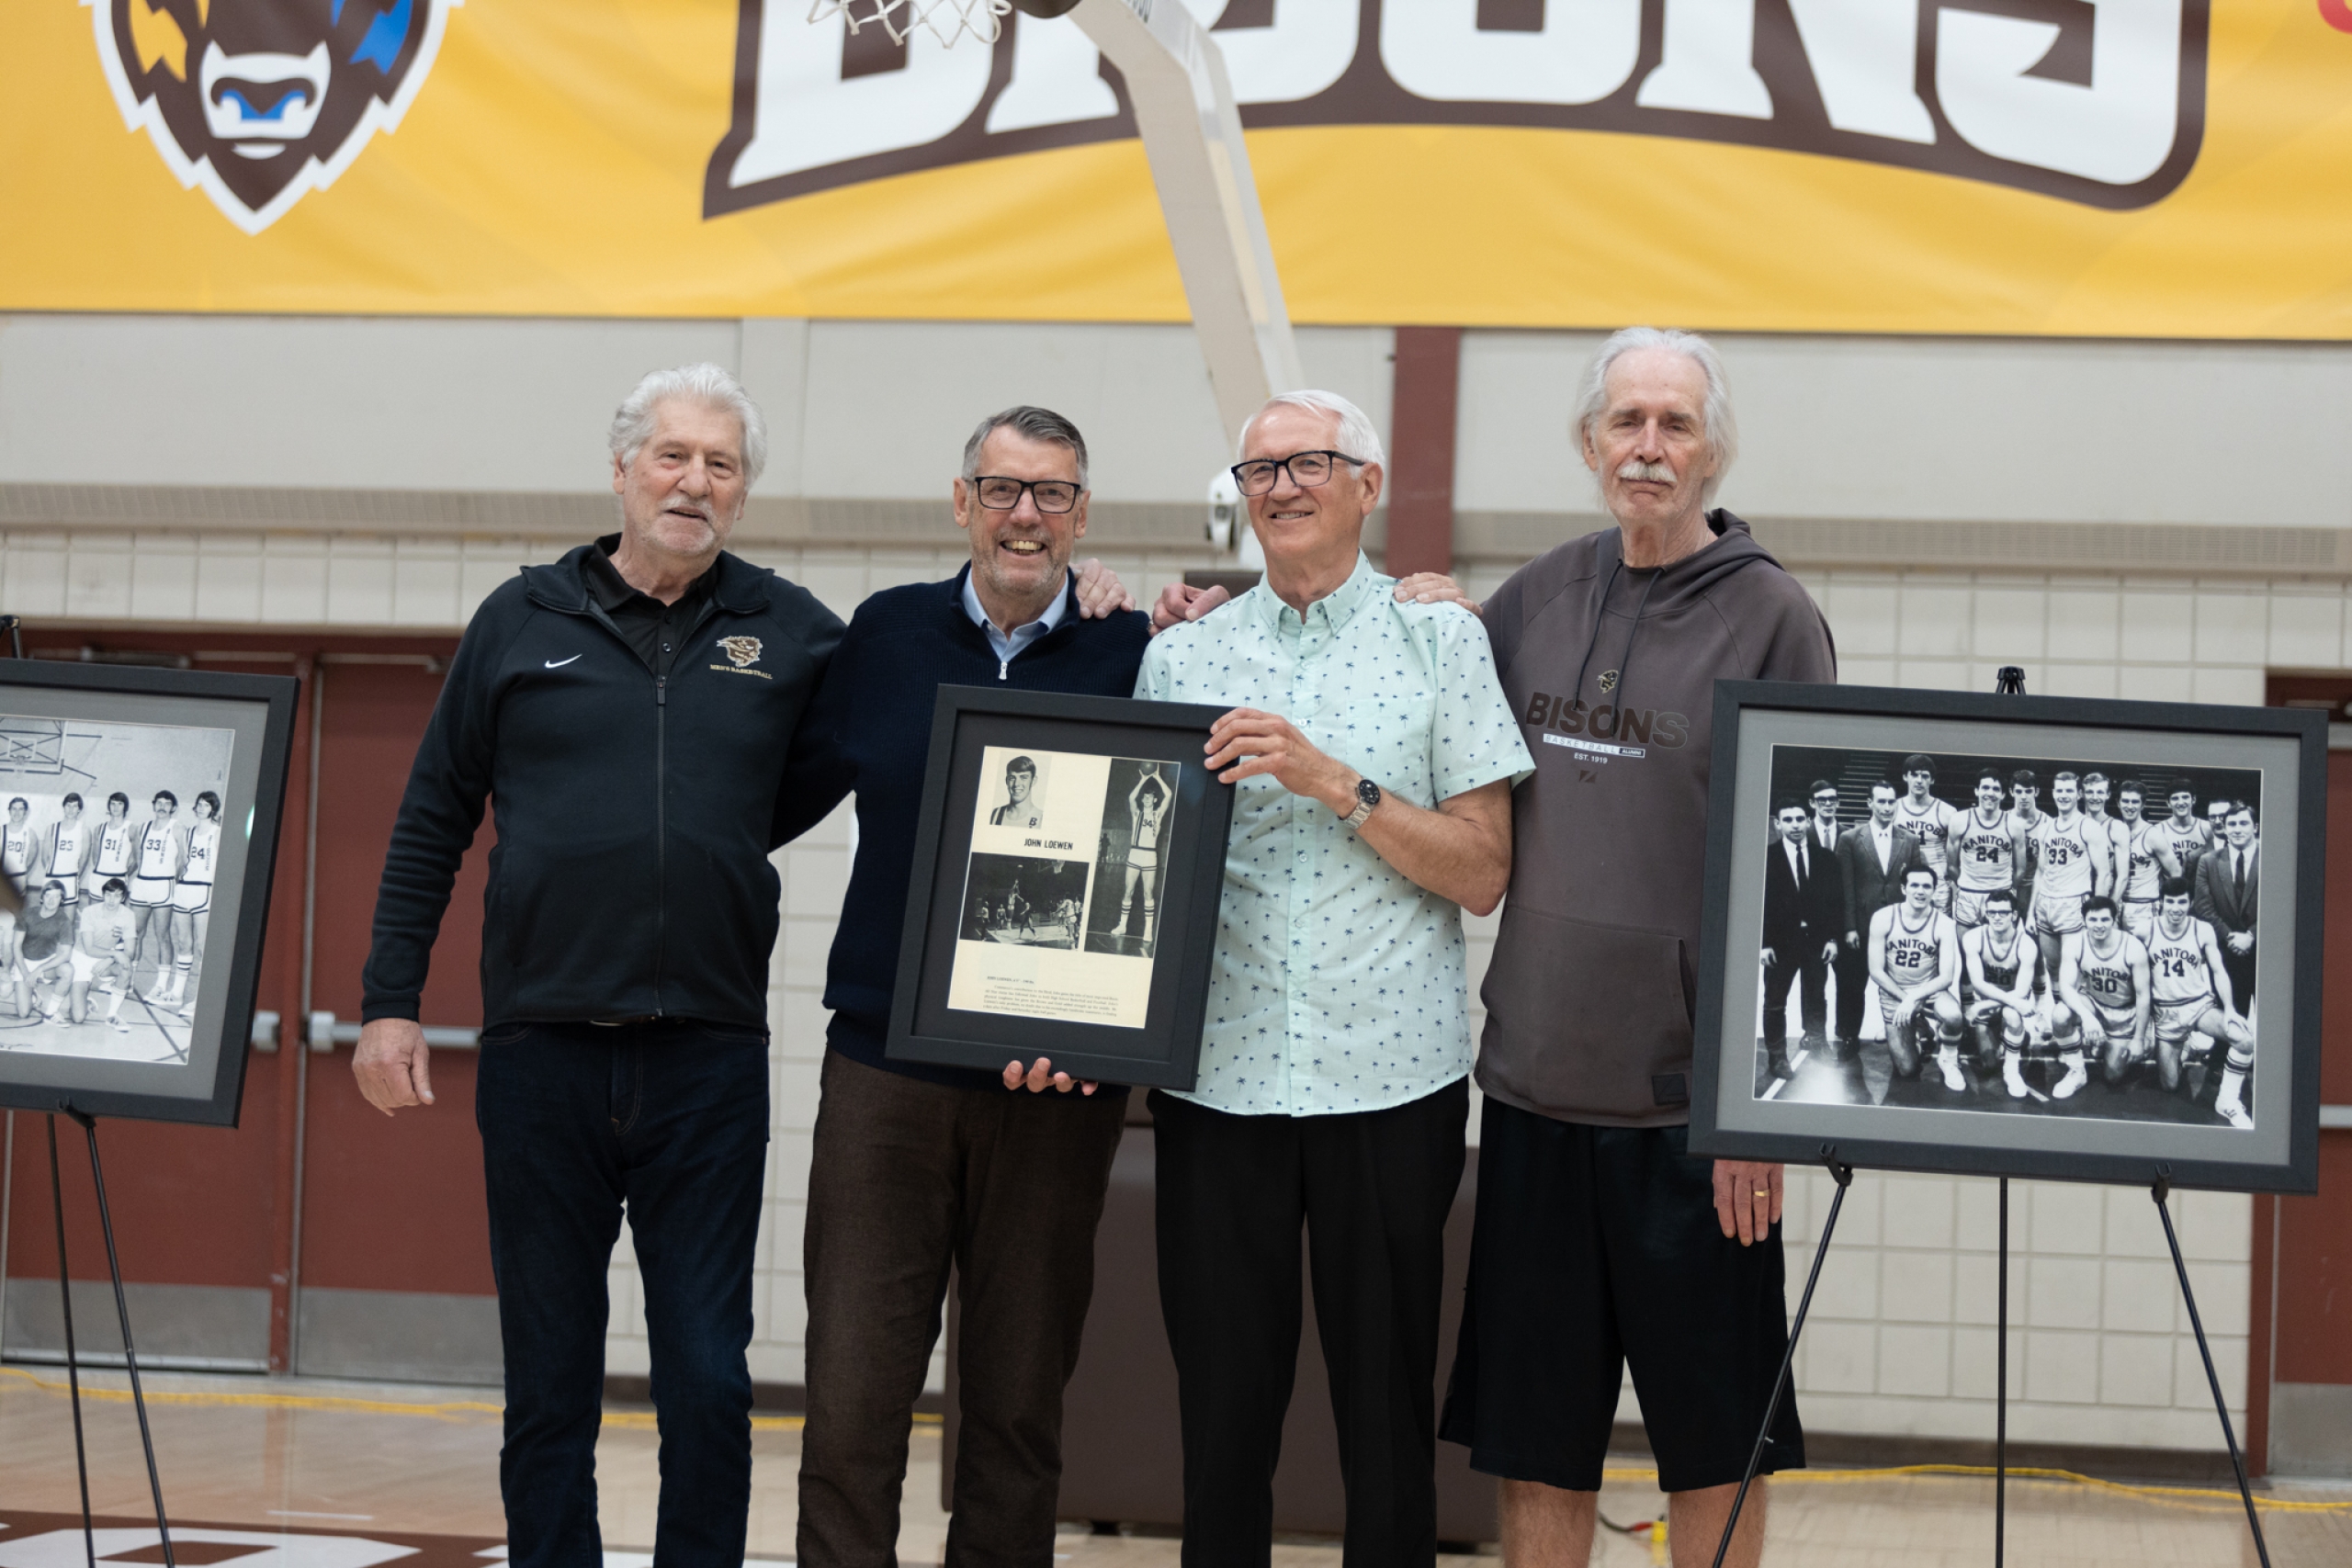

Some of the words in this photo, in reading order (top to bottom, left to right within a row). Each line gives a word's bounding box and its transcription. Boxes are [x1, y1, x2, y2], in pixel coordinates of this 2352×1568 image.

[730, 666, 773, 680] BASKETBALL
[1526, 692, 1690, 750] BISONS
[1544, 734, 1617, 754] BASKETBALL
[1621, 748, 1643, 756] ALUMNI
[1574, 752, 1589, 761] EST.
[1591, 755, 1608, 764] 1919
[1024, 838, 1042, 848] JOHN
[1044, 840, 1073, 851] LOEWEN
[1909, 829, 1927, 845] 1
[7, 840, 22, 852] 20
[59, 840, 74, 851] 23
[105, 839, 117, 851] 31
[146, 839, 162, 851] 33
[190, 846, 205, 859] 24
[1976, 845, 1999, 863] 24
[2048, 848, 2067, 865] 33
[1894, 950, 1921, 968] 22
[2163, 959, 2185, 977] 14
[2092, 976, 2117, 993] 30
